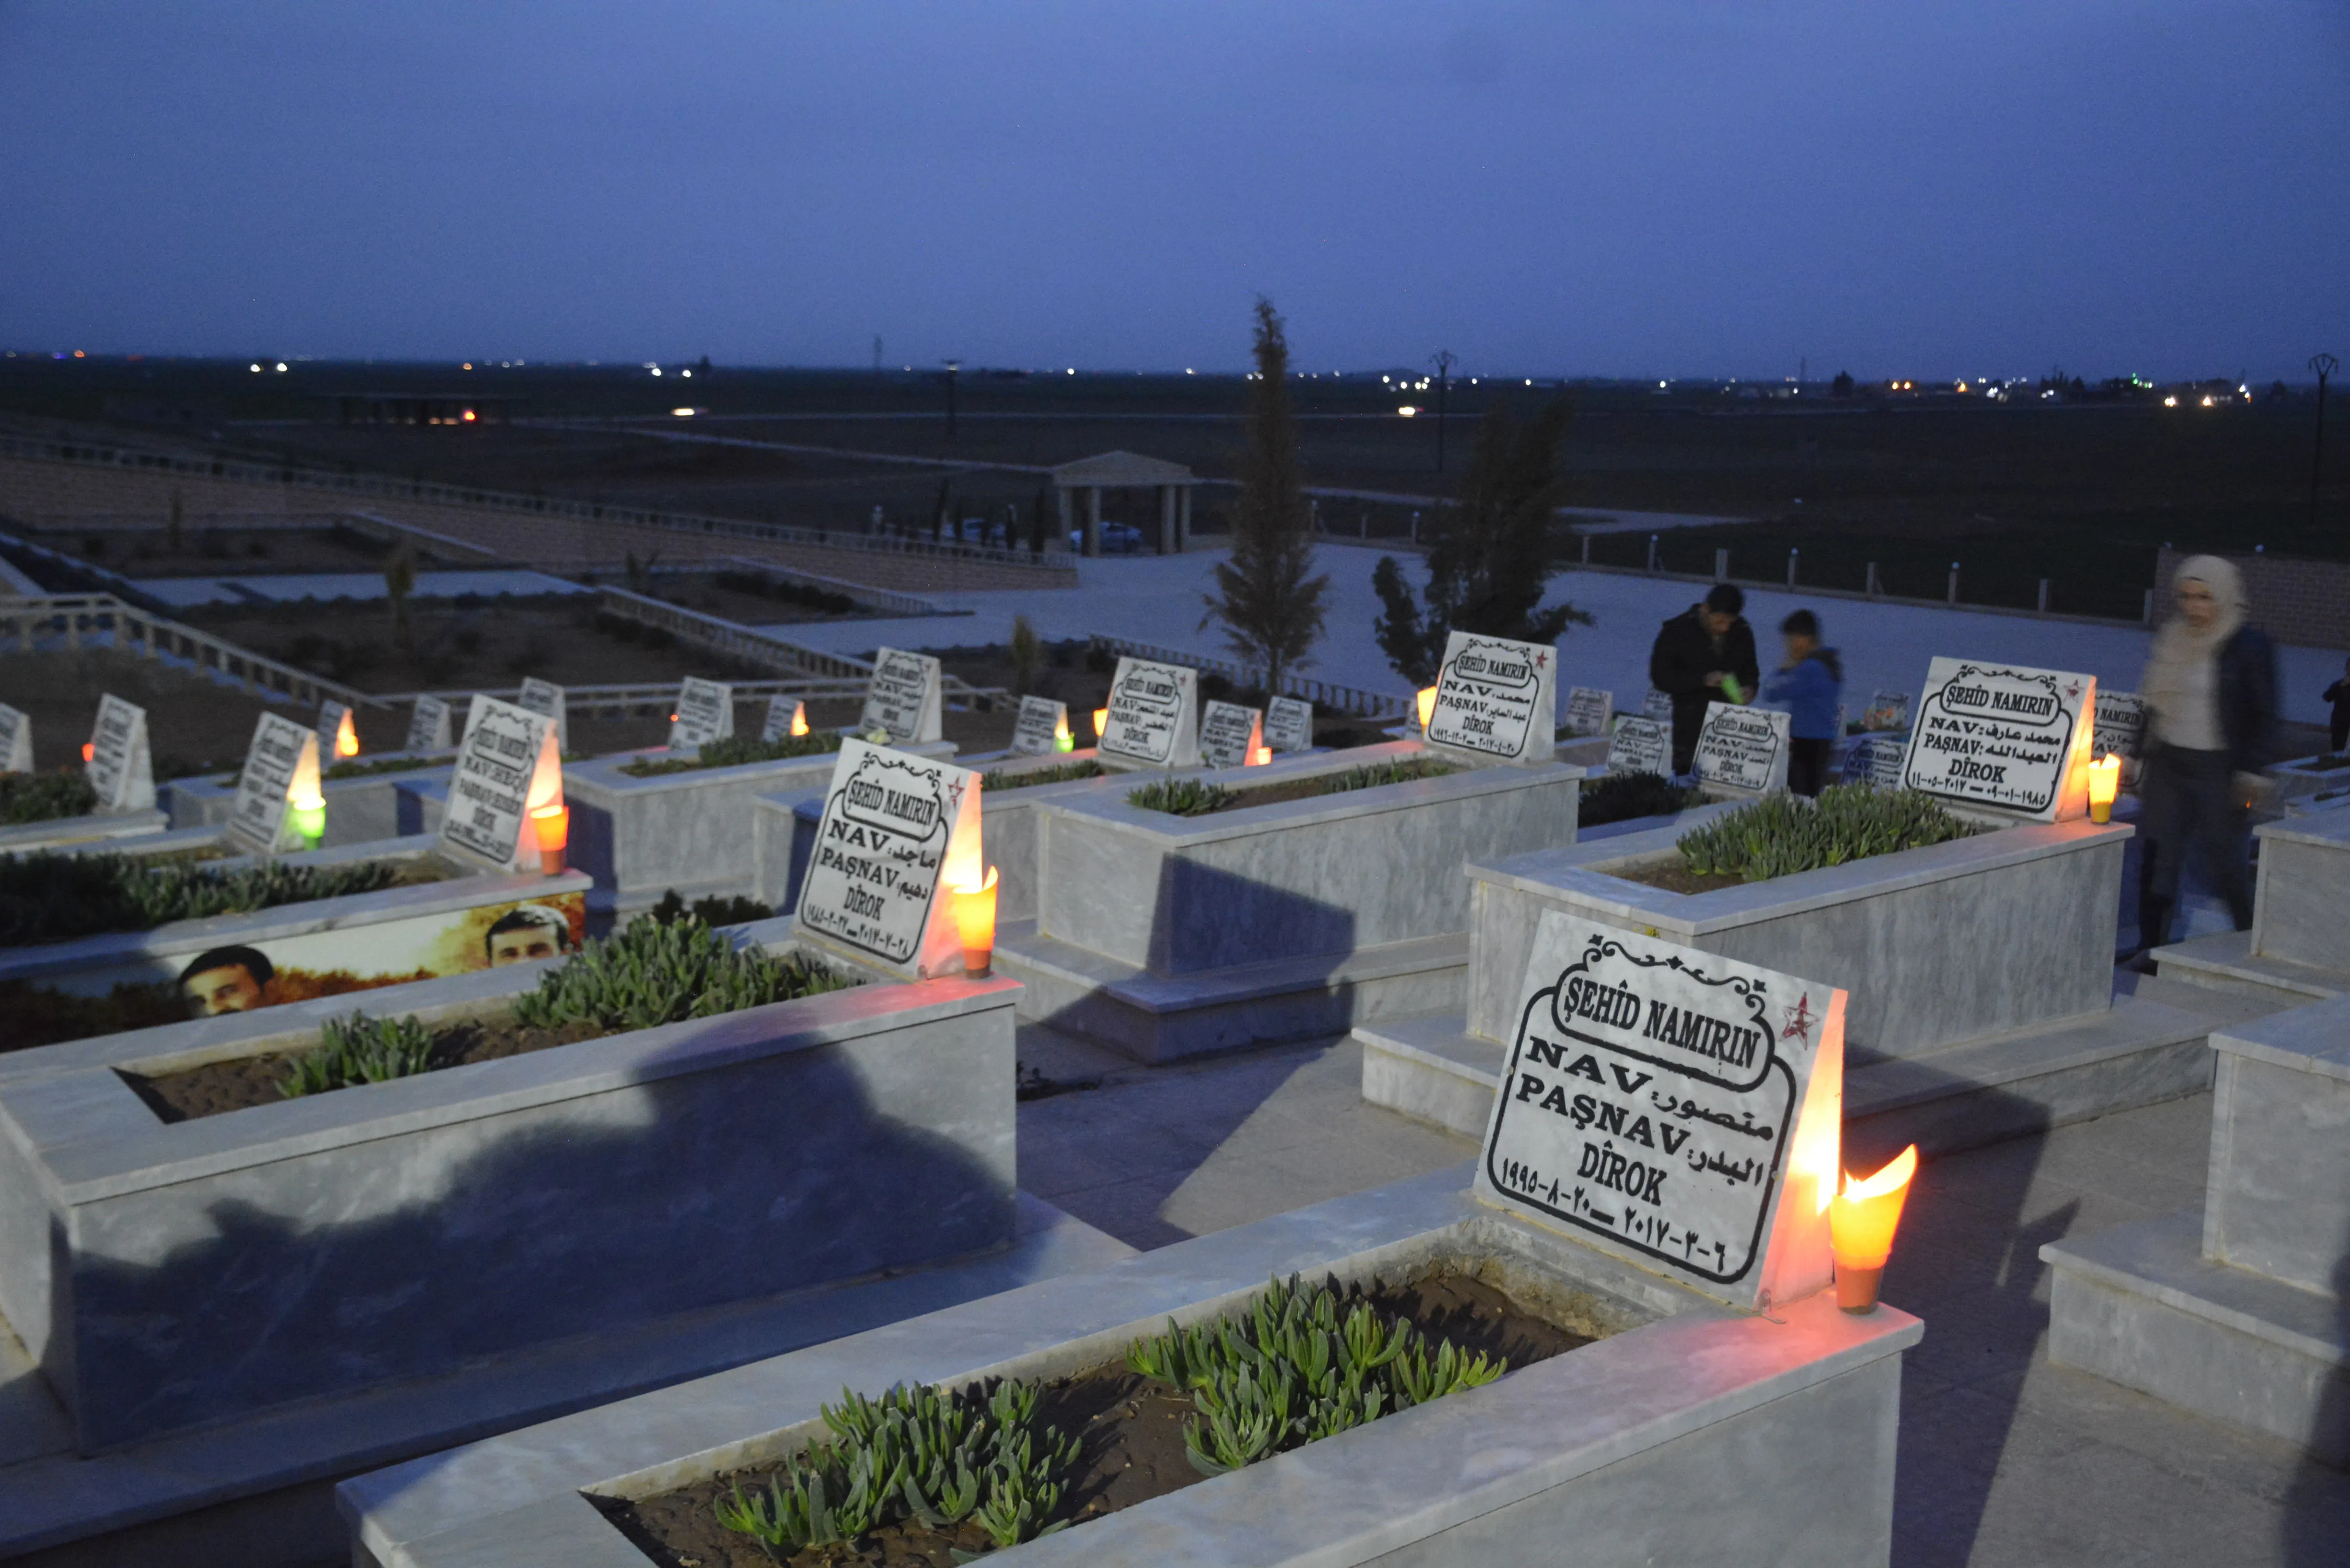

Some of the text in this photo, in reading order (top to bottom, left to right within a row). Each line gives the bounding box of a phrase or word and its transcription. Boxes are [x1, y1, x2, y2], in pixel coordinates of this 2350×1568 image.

[1946, 684, 2054, 717] ŞEHÎD NAMIRIN
[1462, 714, 1494, 735] DÎROK
[2024, 732, 2061, 745] محمد
[1949, 757, 2007, 783] DÎROK
[847, 779, 936, 825] ŞEHÎD NAMIRIN
[844, 883, 885, 921] DÎROK
[1563, 978, 1761, 1070] ŞEHÎD NAMIRIN
[1577, 1140, 1667, 1206] DÎROK
